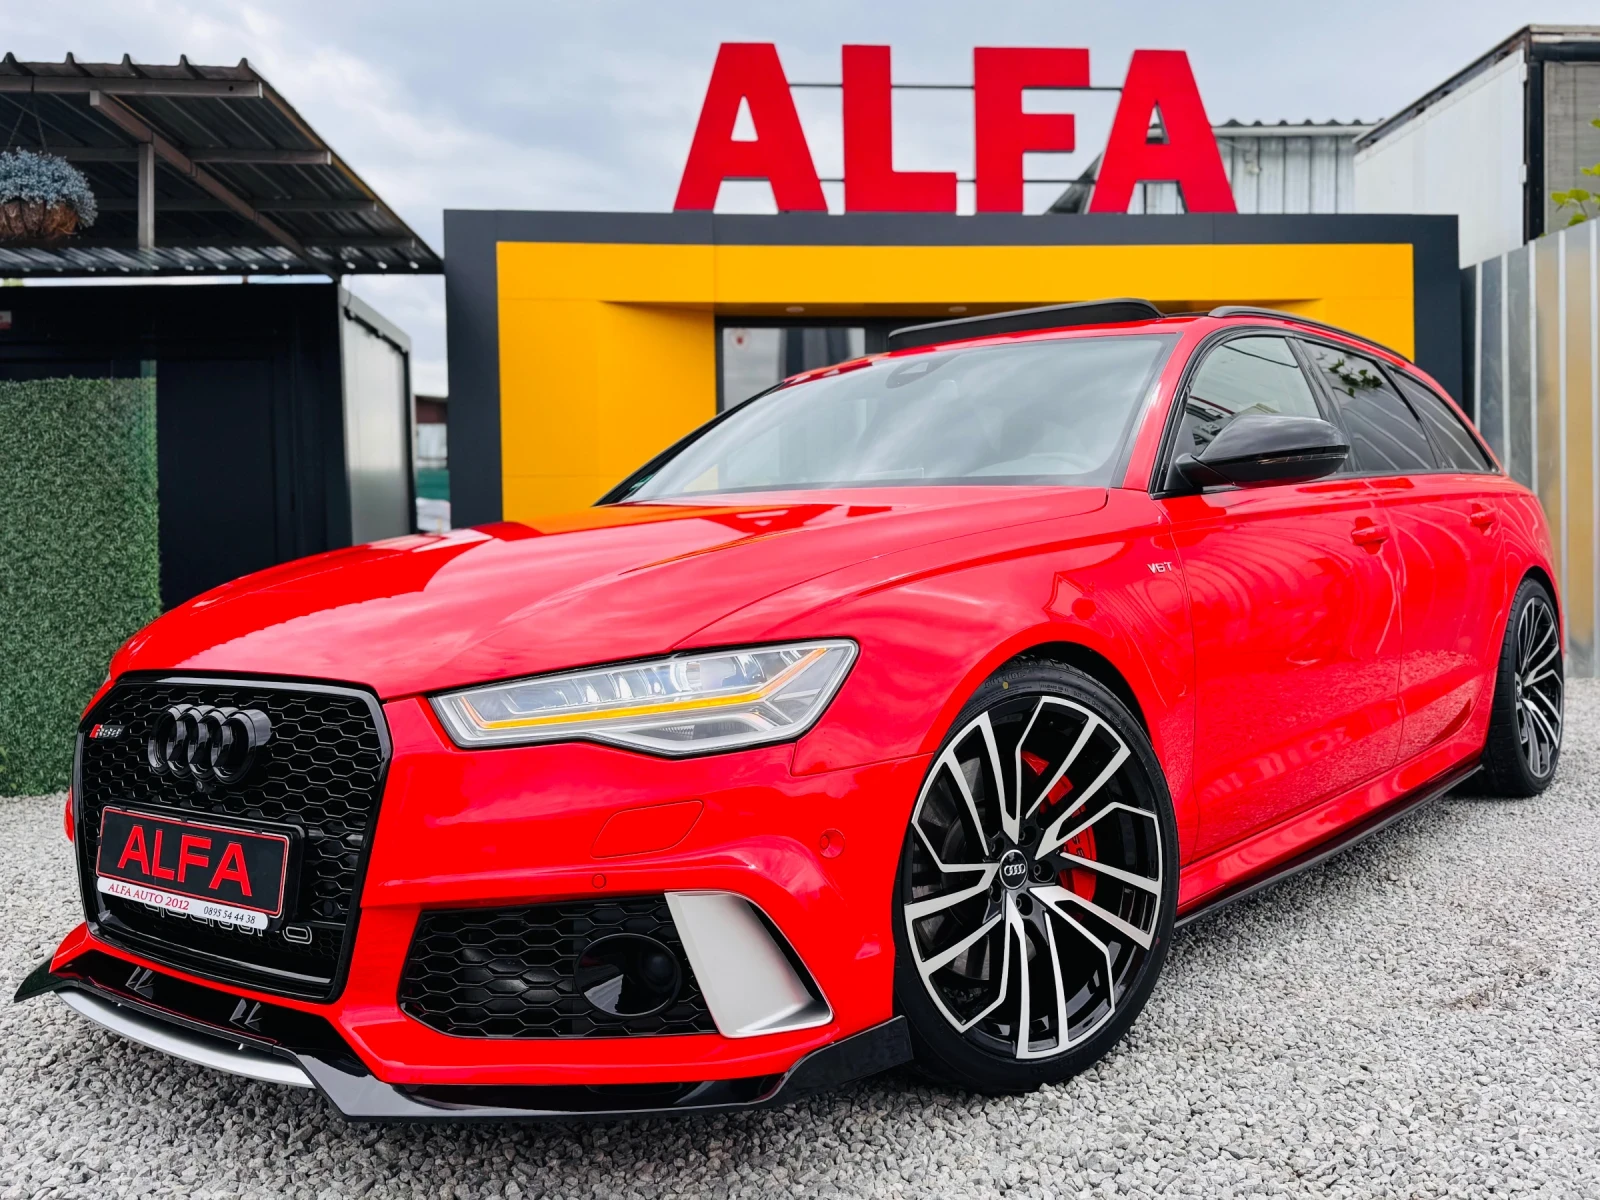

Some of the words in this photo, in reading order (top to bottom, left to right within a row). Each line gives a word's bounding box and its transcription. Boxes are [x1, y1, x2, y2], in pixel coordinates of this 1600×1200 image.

[673, 42, 1237, 213] ALFA
[1147, 562, 1172, 574] V6T
[117, 825, 252, 896] ALFA
[108, 884, 131, 897] ALFA
[133, 890, 164, 904] AUTO
[165, 896, 190, 911] 2012
[203, 906, 221, 918] 0895
[222, 910, 232, 920] 54
[233, 913, 244, 922] 44
[245, 914, 256, 925] 38
